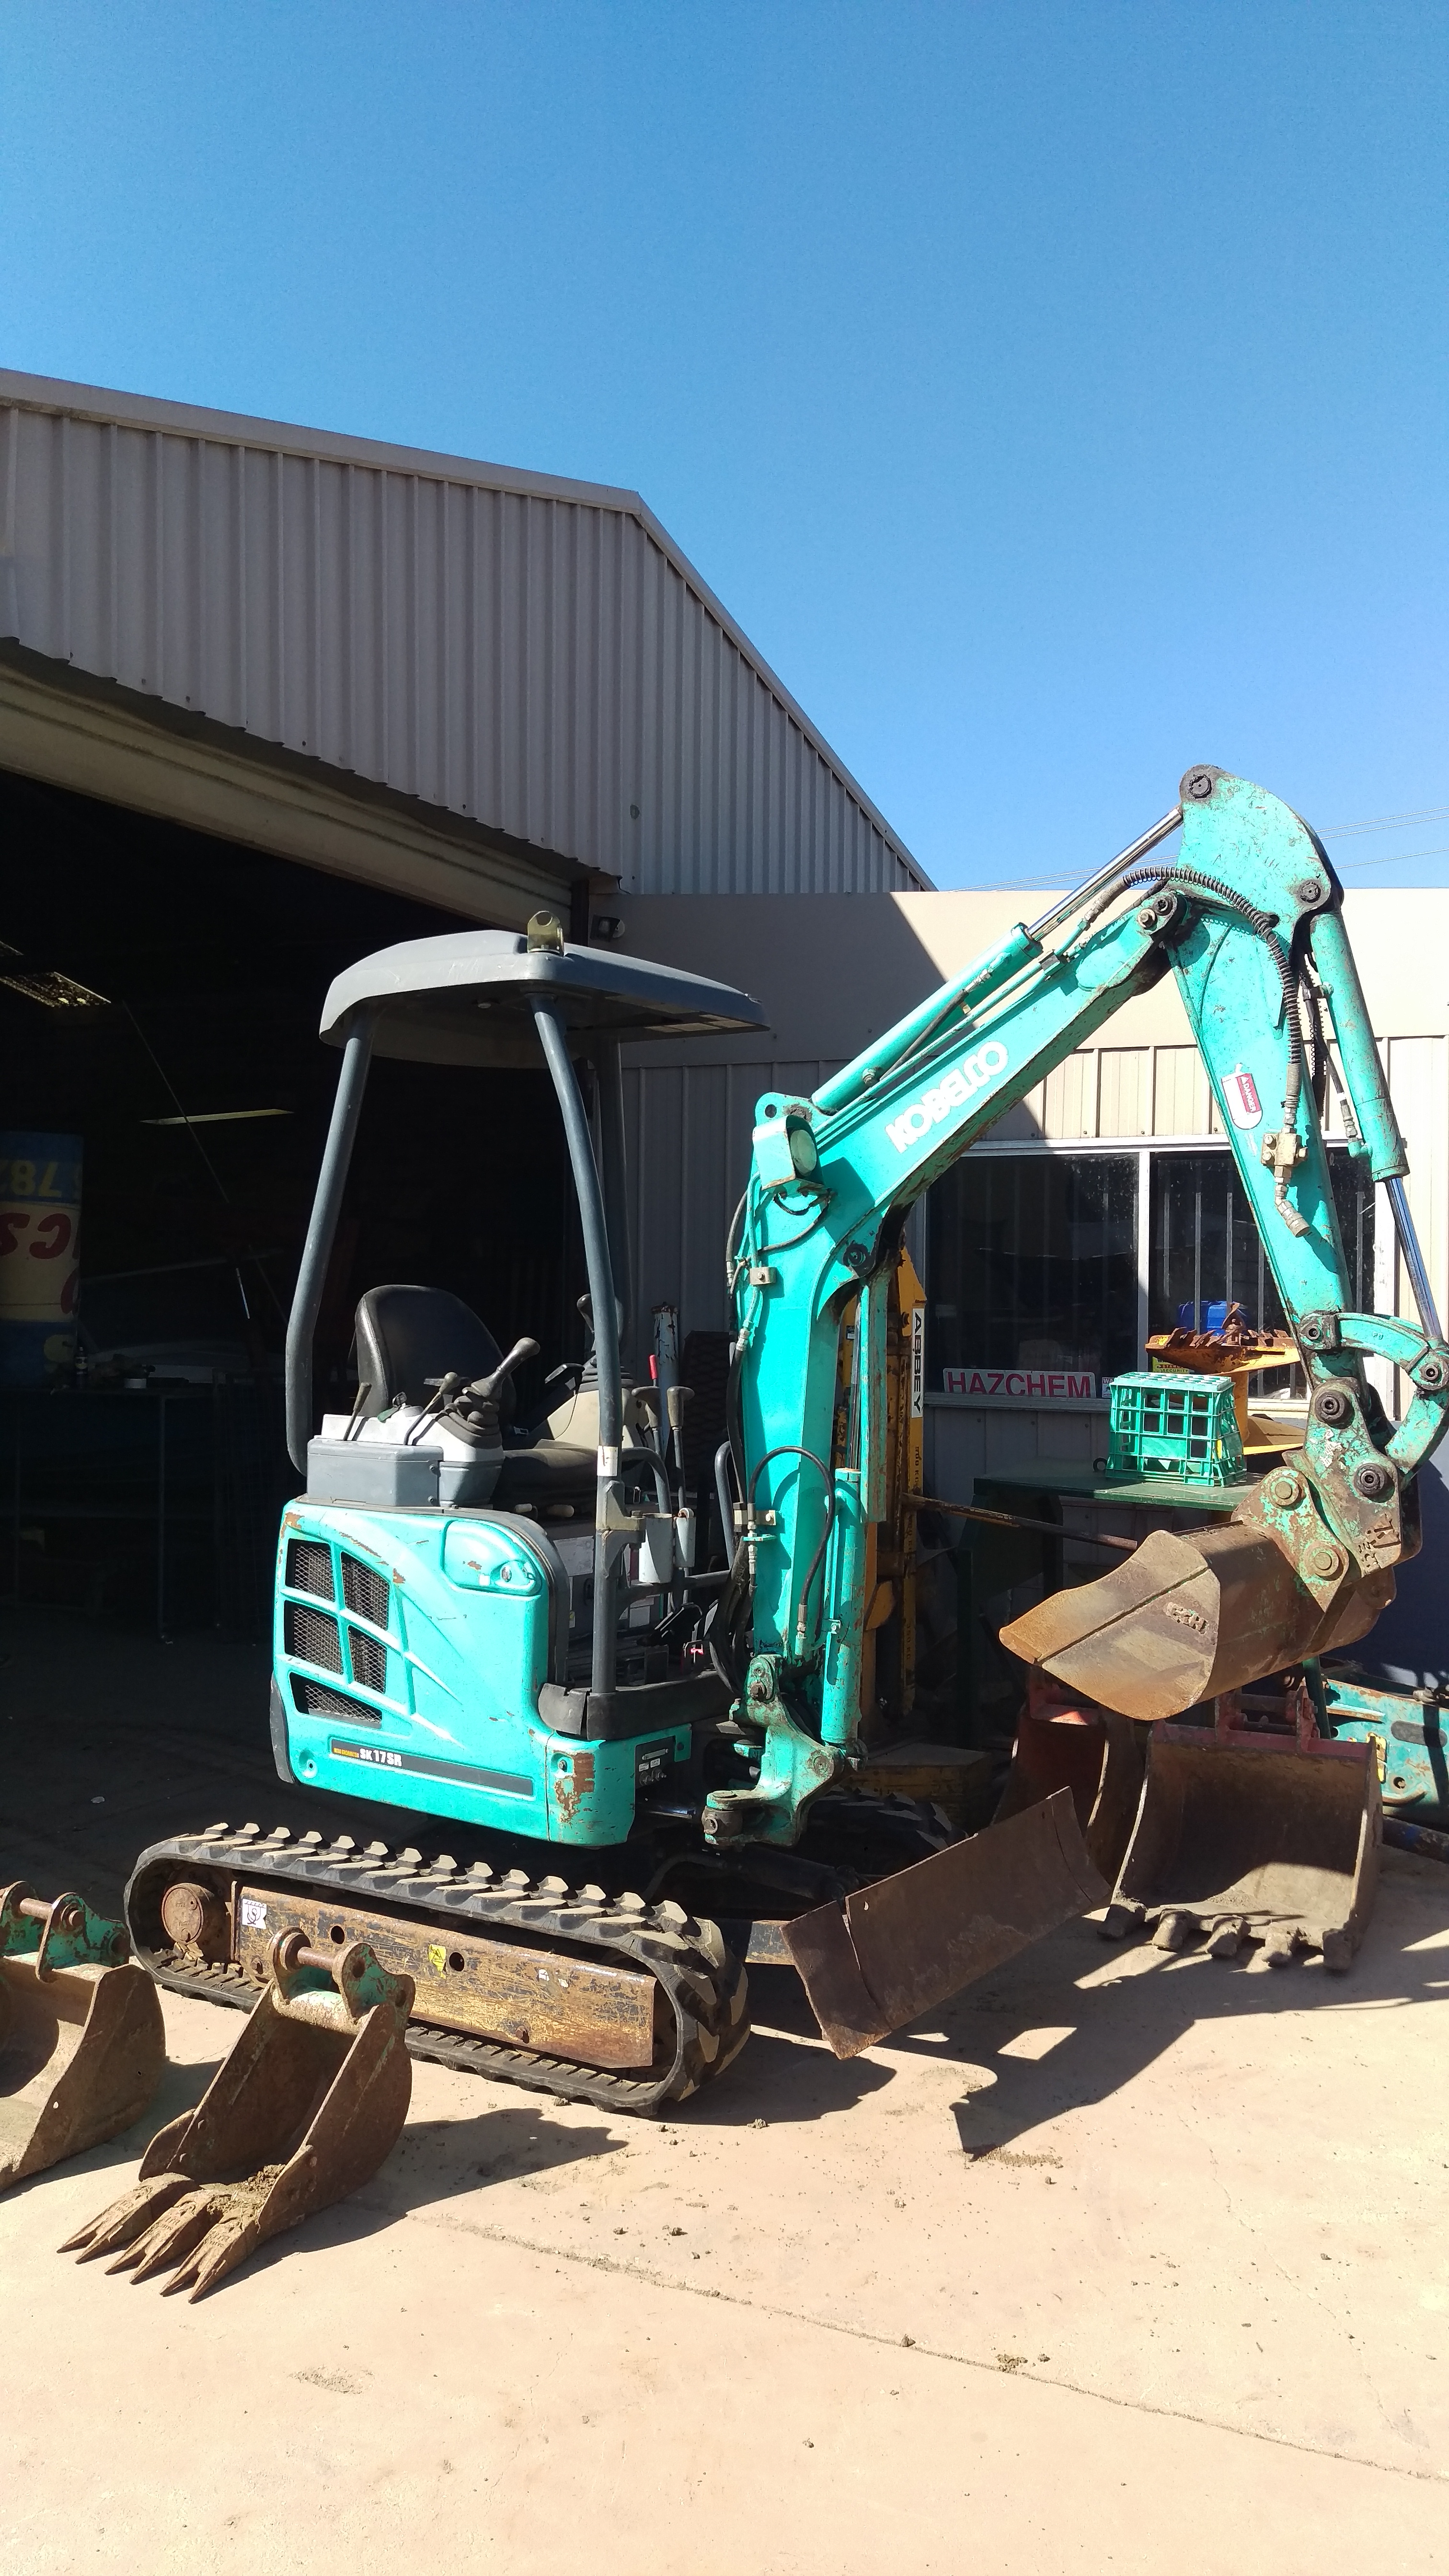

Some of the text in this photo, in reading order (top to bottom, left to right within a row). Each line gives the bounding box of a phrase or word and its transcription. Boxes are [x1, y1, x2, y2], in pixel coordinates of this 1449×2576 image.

[885, 1040, 1009, 1154] KOBELCO
[1243, 1082, 1257, 1112] DANGER
[914, 1312, 922, 1414] ABBEY
[947, 1371, 1092, 1399] HAZCHEM
